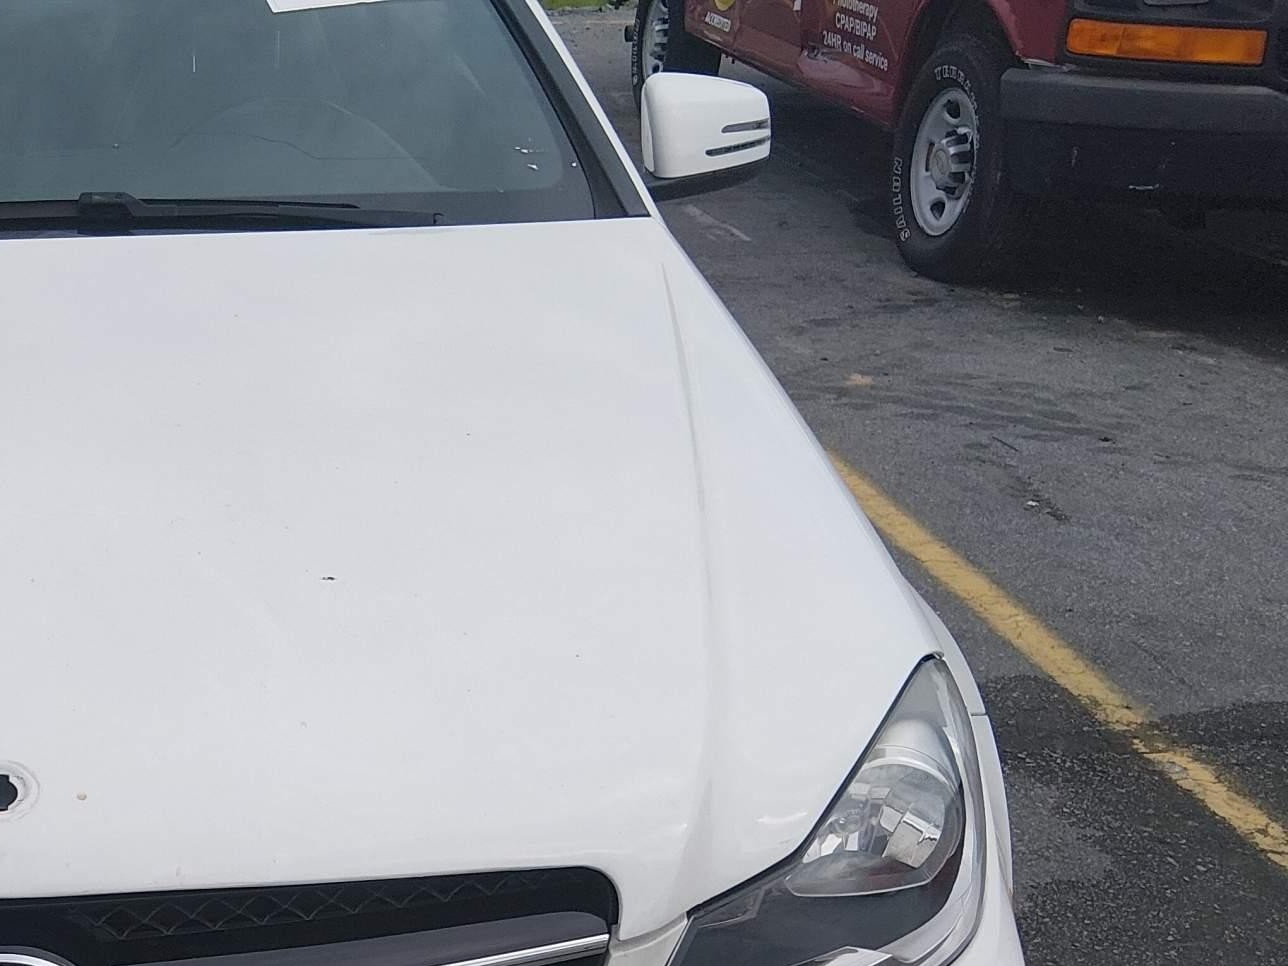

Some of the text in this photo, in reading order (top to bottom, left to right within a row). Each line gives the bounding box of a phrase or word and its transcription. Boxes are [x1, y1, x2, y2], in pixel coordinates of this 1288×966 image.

[835, 12, 877, 40] CPAP/BIPAP
[822, 30, 888, 72] 24HR on call service
